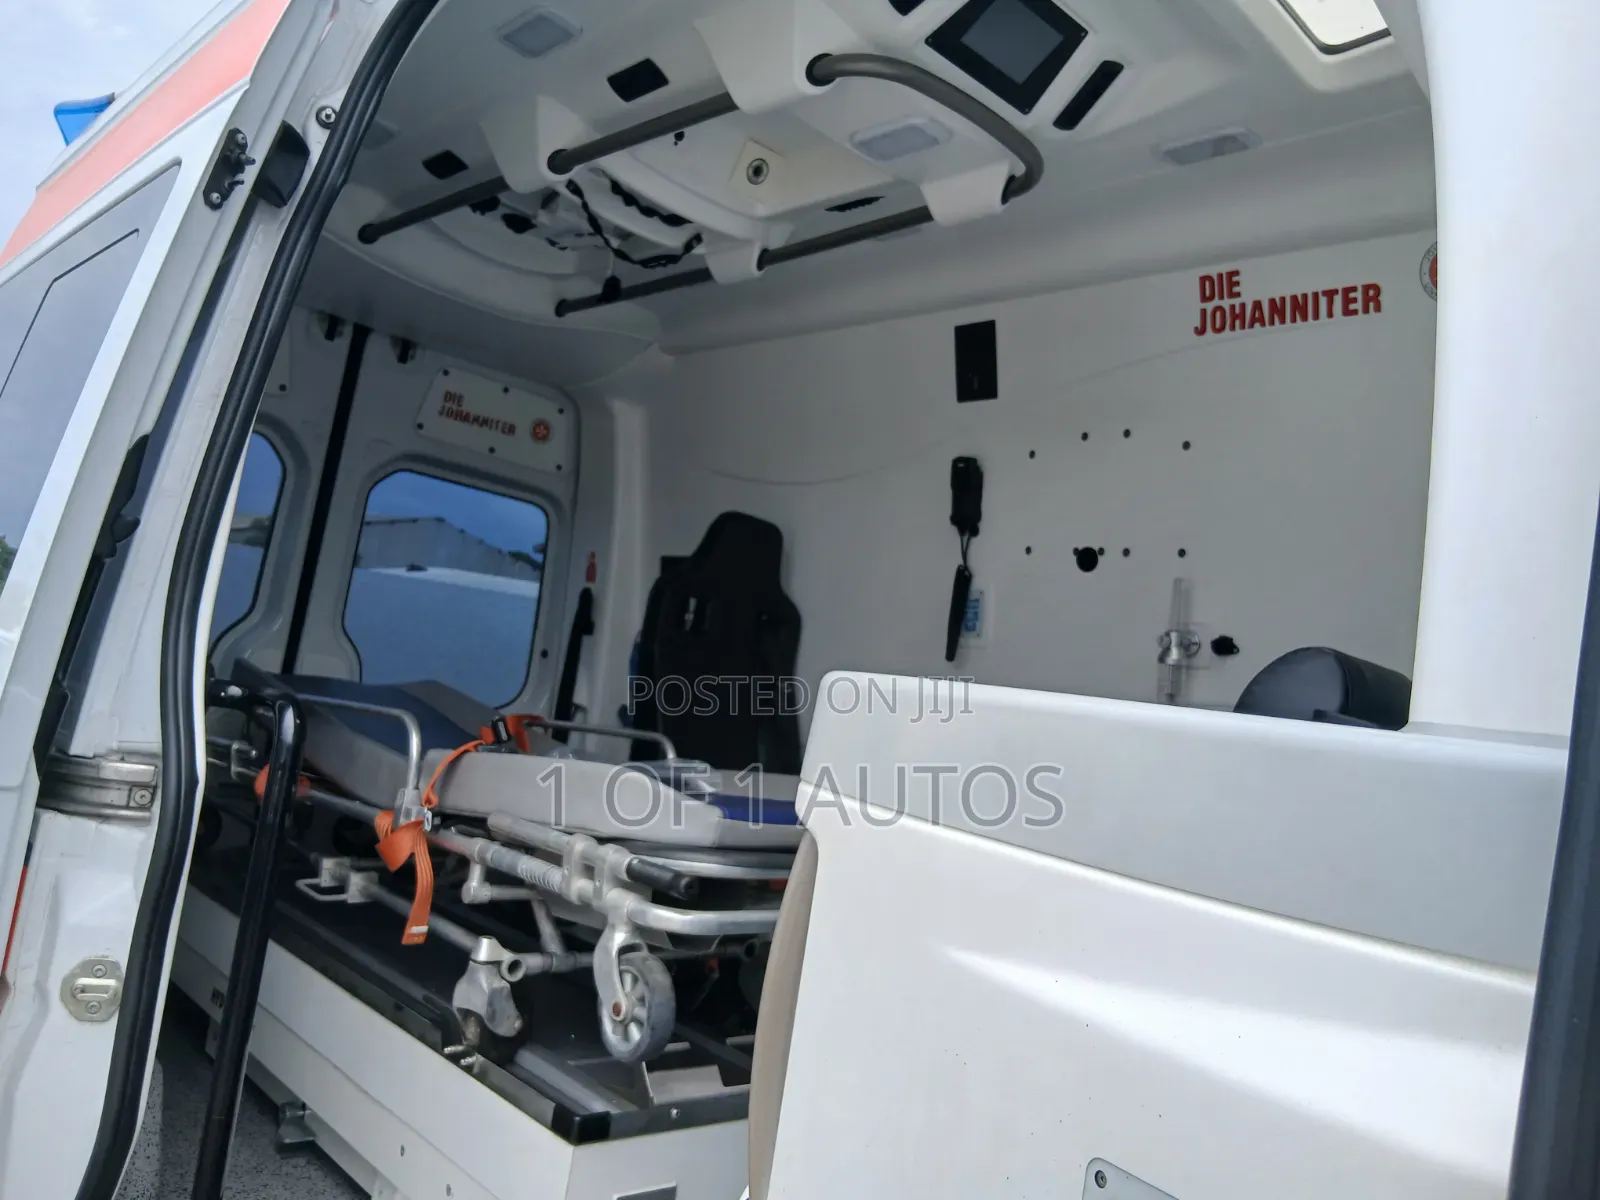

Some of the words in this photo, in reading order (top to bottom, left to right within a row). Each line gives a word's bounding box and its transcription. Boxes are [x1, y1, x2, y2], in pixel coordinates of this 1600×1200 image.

[1198, 269, 1242, 303] DIE
[1193, 283, 1382, 337] JOHANNITER
[443, 390, 465, 407] DIE
[438, 404, 517, 436] JOHANNITER
